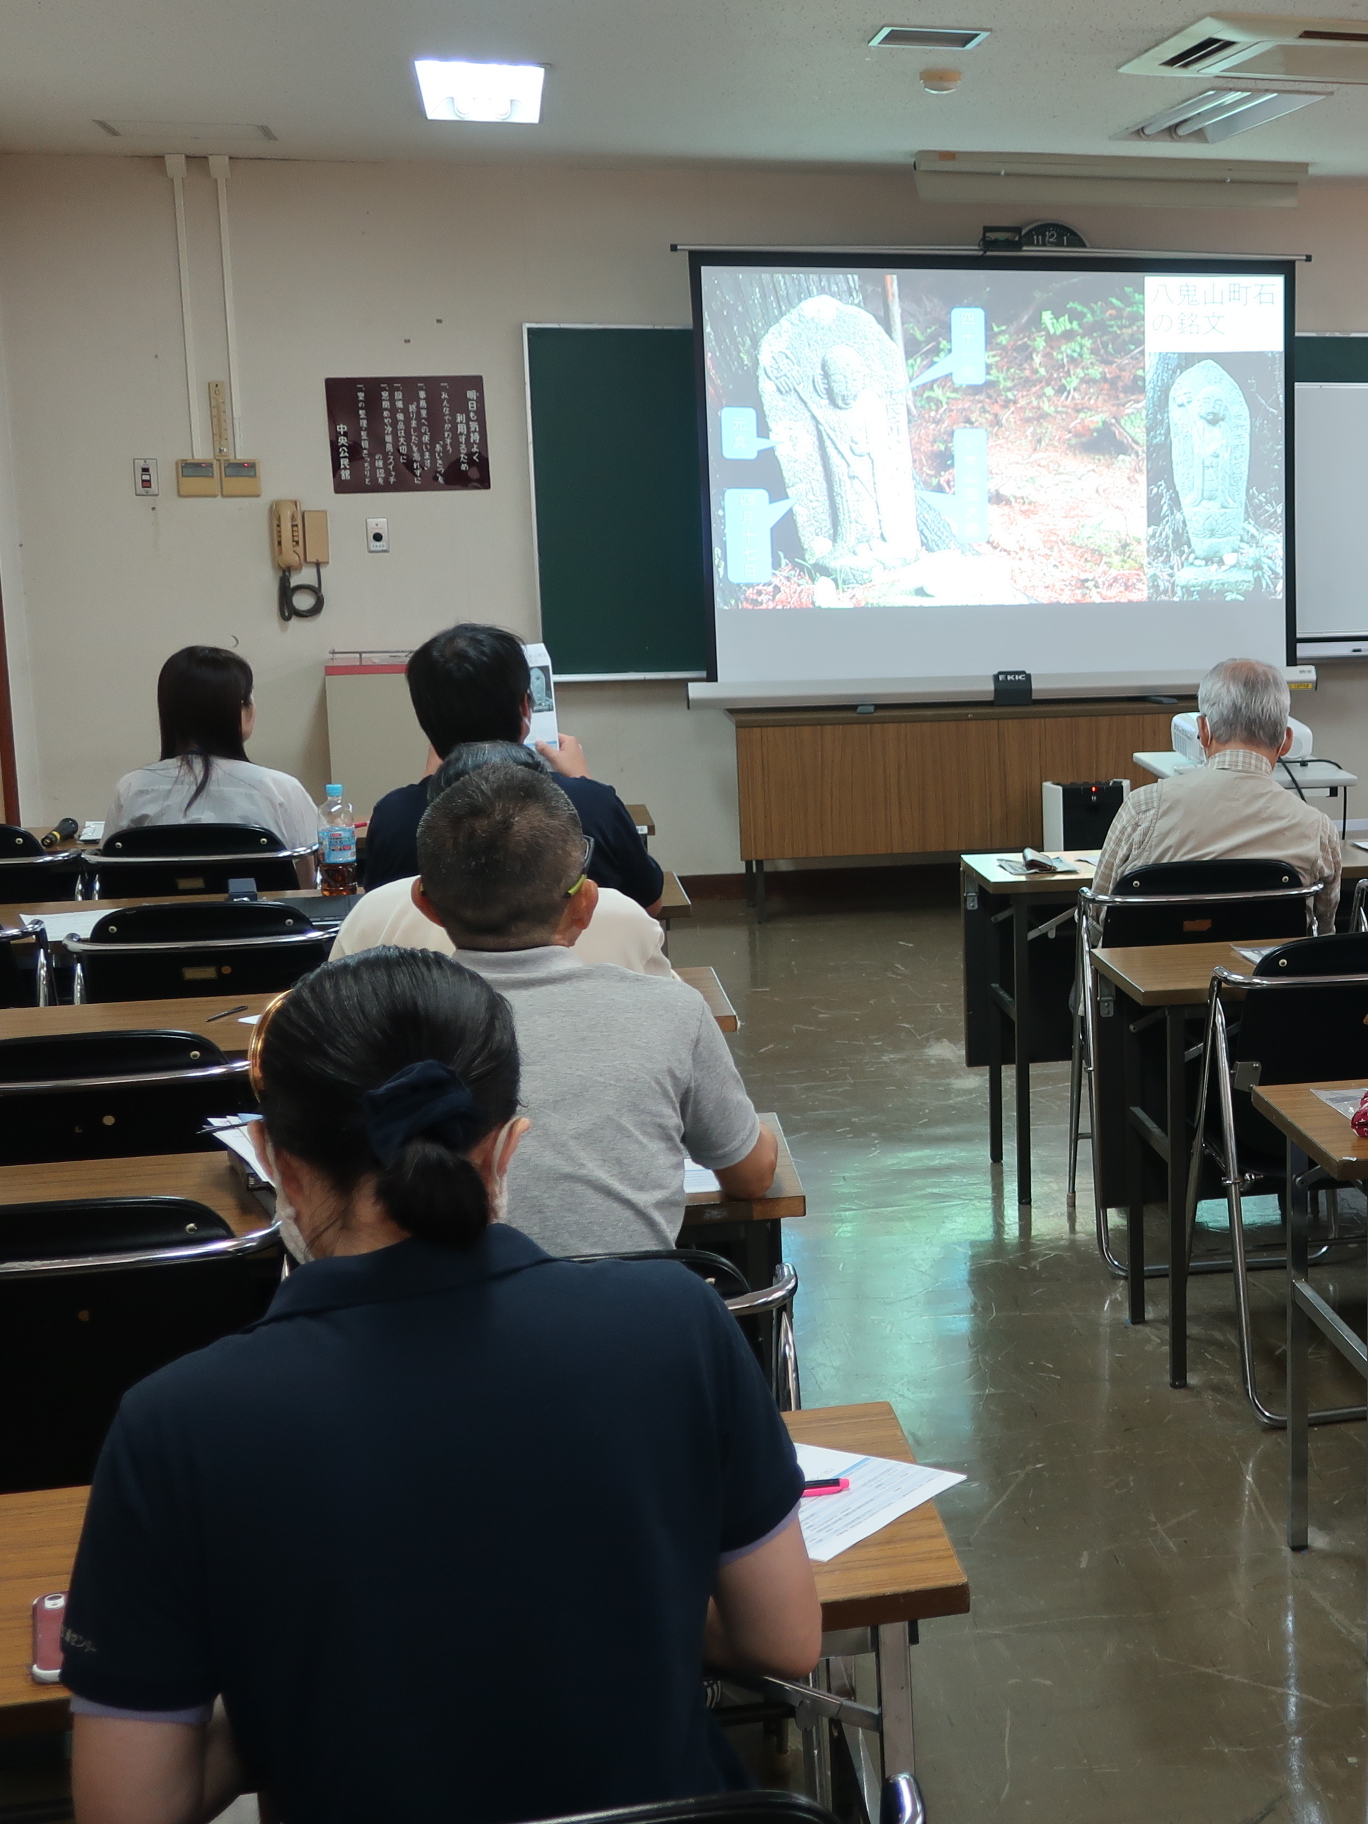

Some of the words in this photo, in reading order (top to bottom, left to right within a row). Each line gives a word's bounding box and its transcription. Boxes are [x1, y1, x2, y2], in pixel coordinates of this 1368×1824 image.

[1034, 235, 1042, 245] 11
[1045, 230, 1057, 242] 12
[1150, 282, 1276, 306] 八鬼山町石
[1152, 311, 1225, 335] の銘文
[456, 413, 469, 471] 利用するため
[466, 389, 480, 462] 明日も気持よく
[336, 423, 351, 480] 中央公民館
[739, 493, 757, 577] 四月十七日
